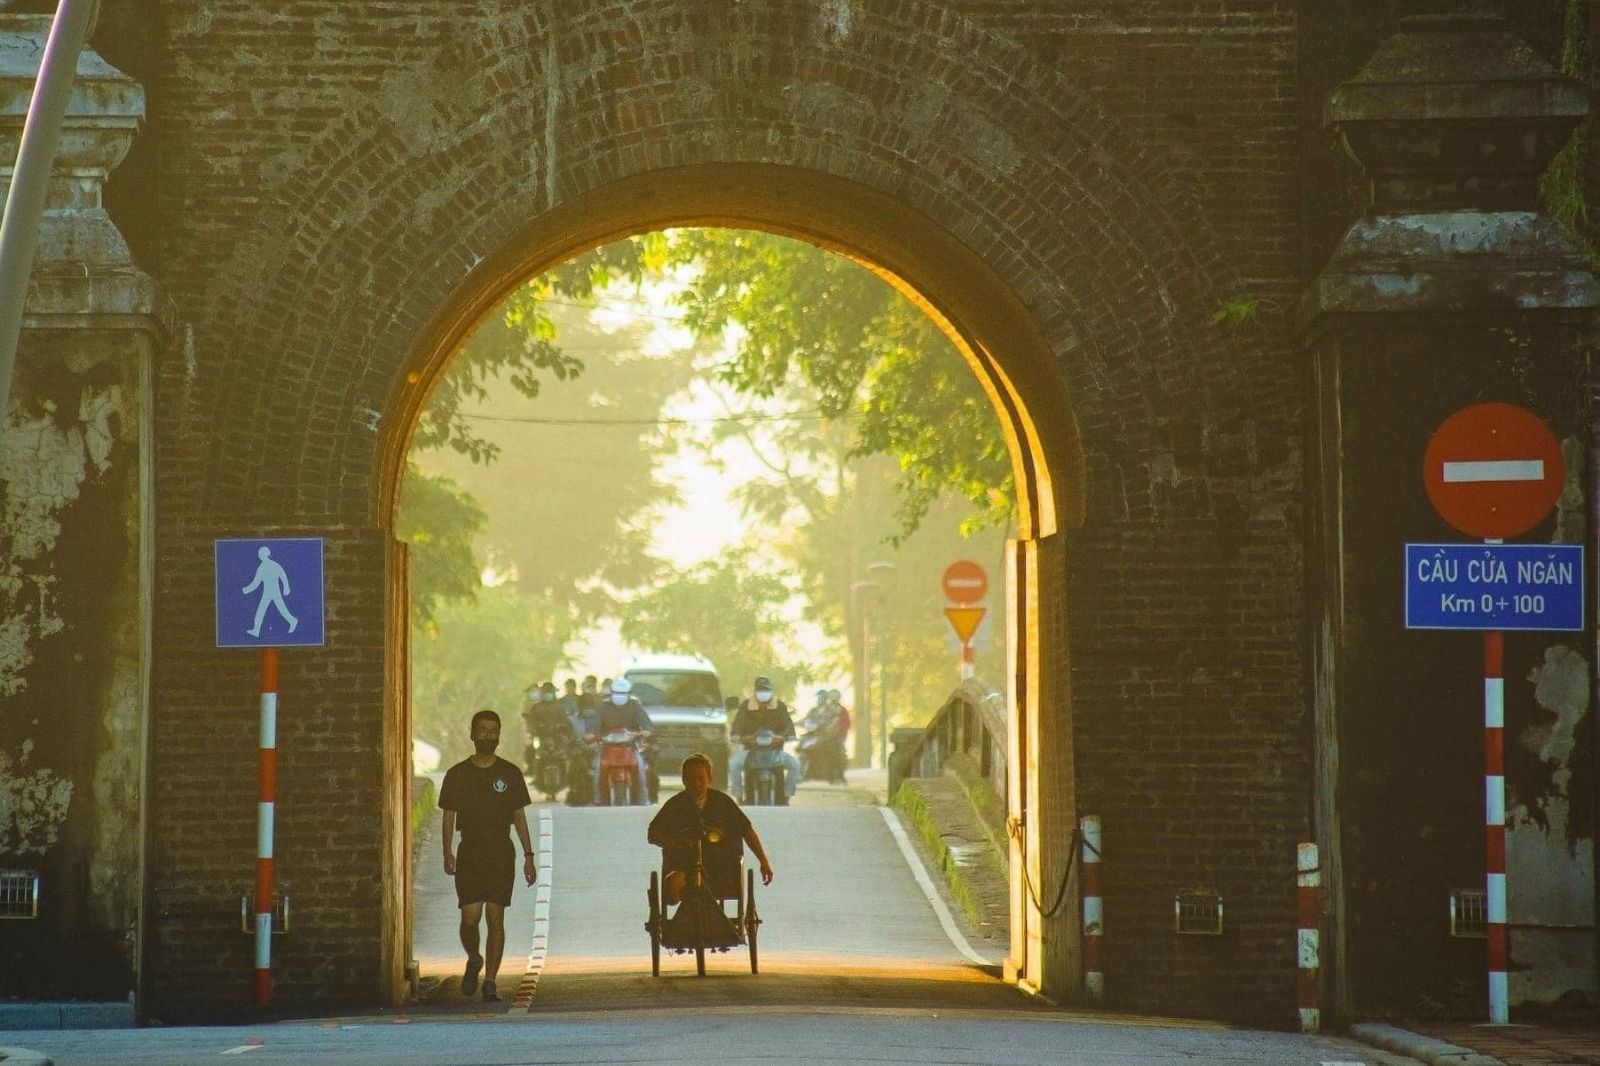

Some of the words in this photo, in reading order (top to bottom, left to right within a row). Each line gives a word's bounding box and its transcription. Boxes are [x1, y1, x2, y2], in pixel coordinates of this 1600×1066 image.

[1418, 549, 1458, 583] CẦU
[1468, 551, 1508, 584] CỬA
[1518, 554, 1573, 585] NGĂN
[1441, 593, 1475, 613] Km
